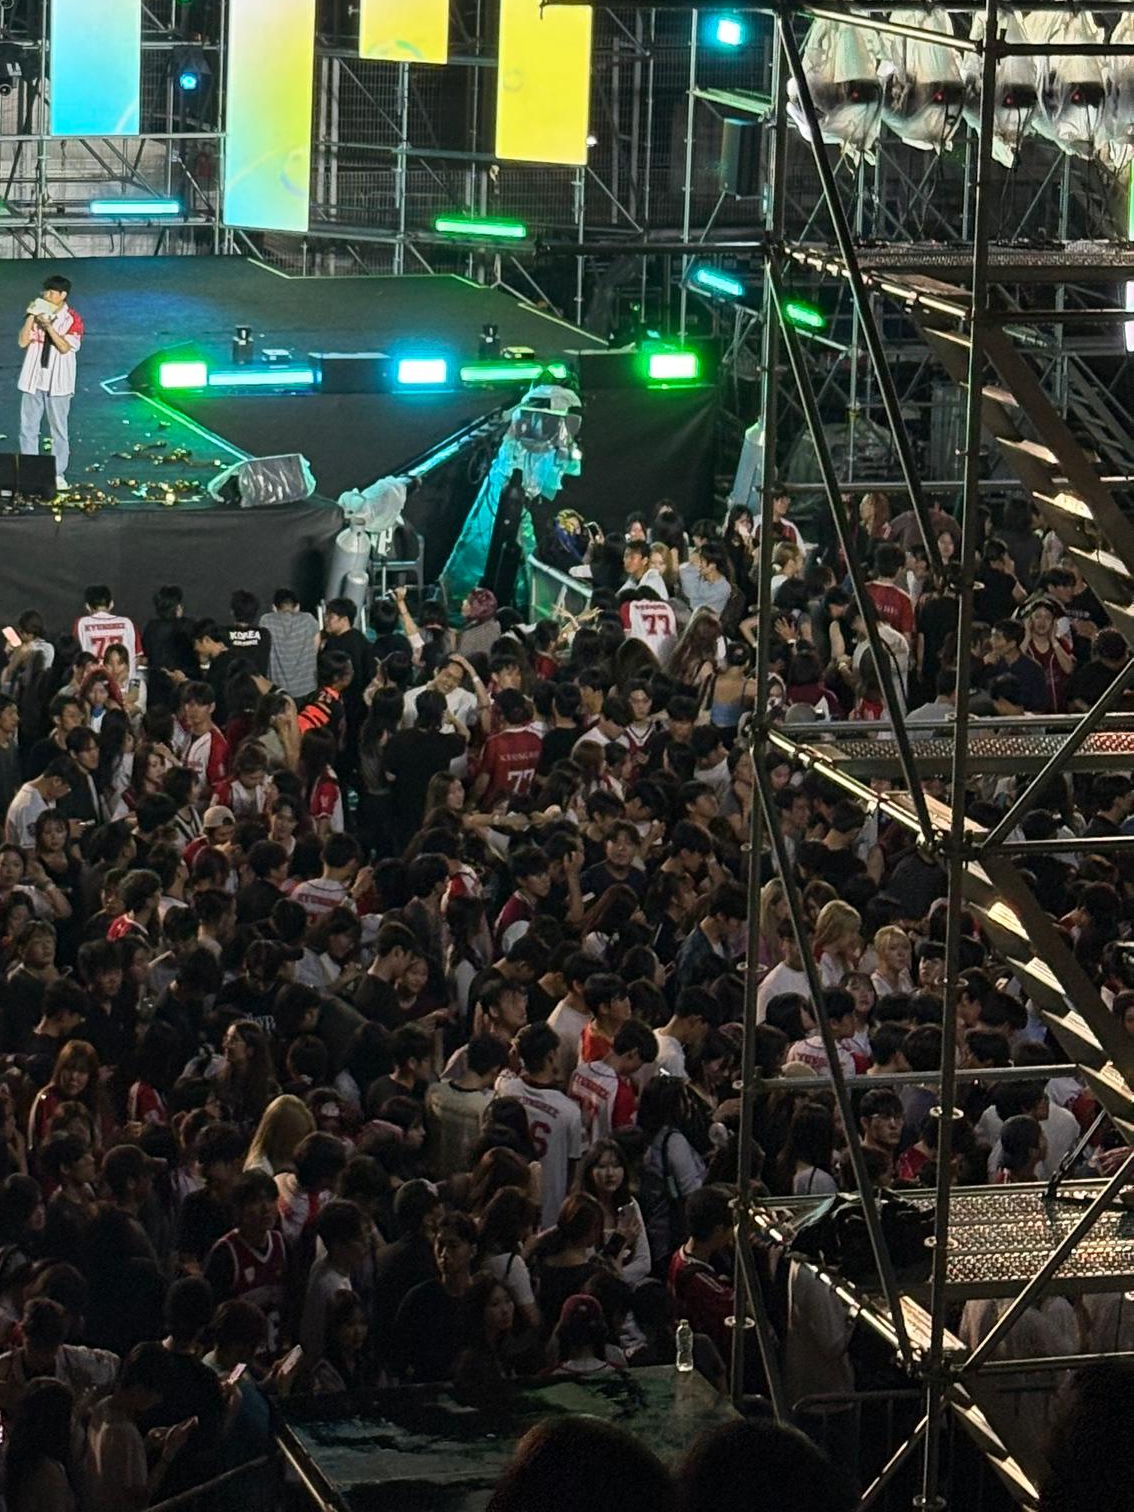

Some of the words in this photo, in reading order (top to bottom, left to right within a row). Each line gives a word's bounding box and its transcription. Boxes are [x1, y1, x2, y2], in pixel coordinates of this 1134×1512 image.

[642, 614, 672, 635] 77
[229, 630, 261, 641] KOREA
[507, 768, 536, 795] 77
